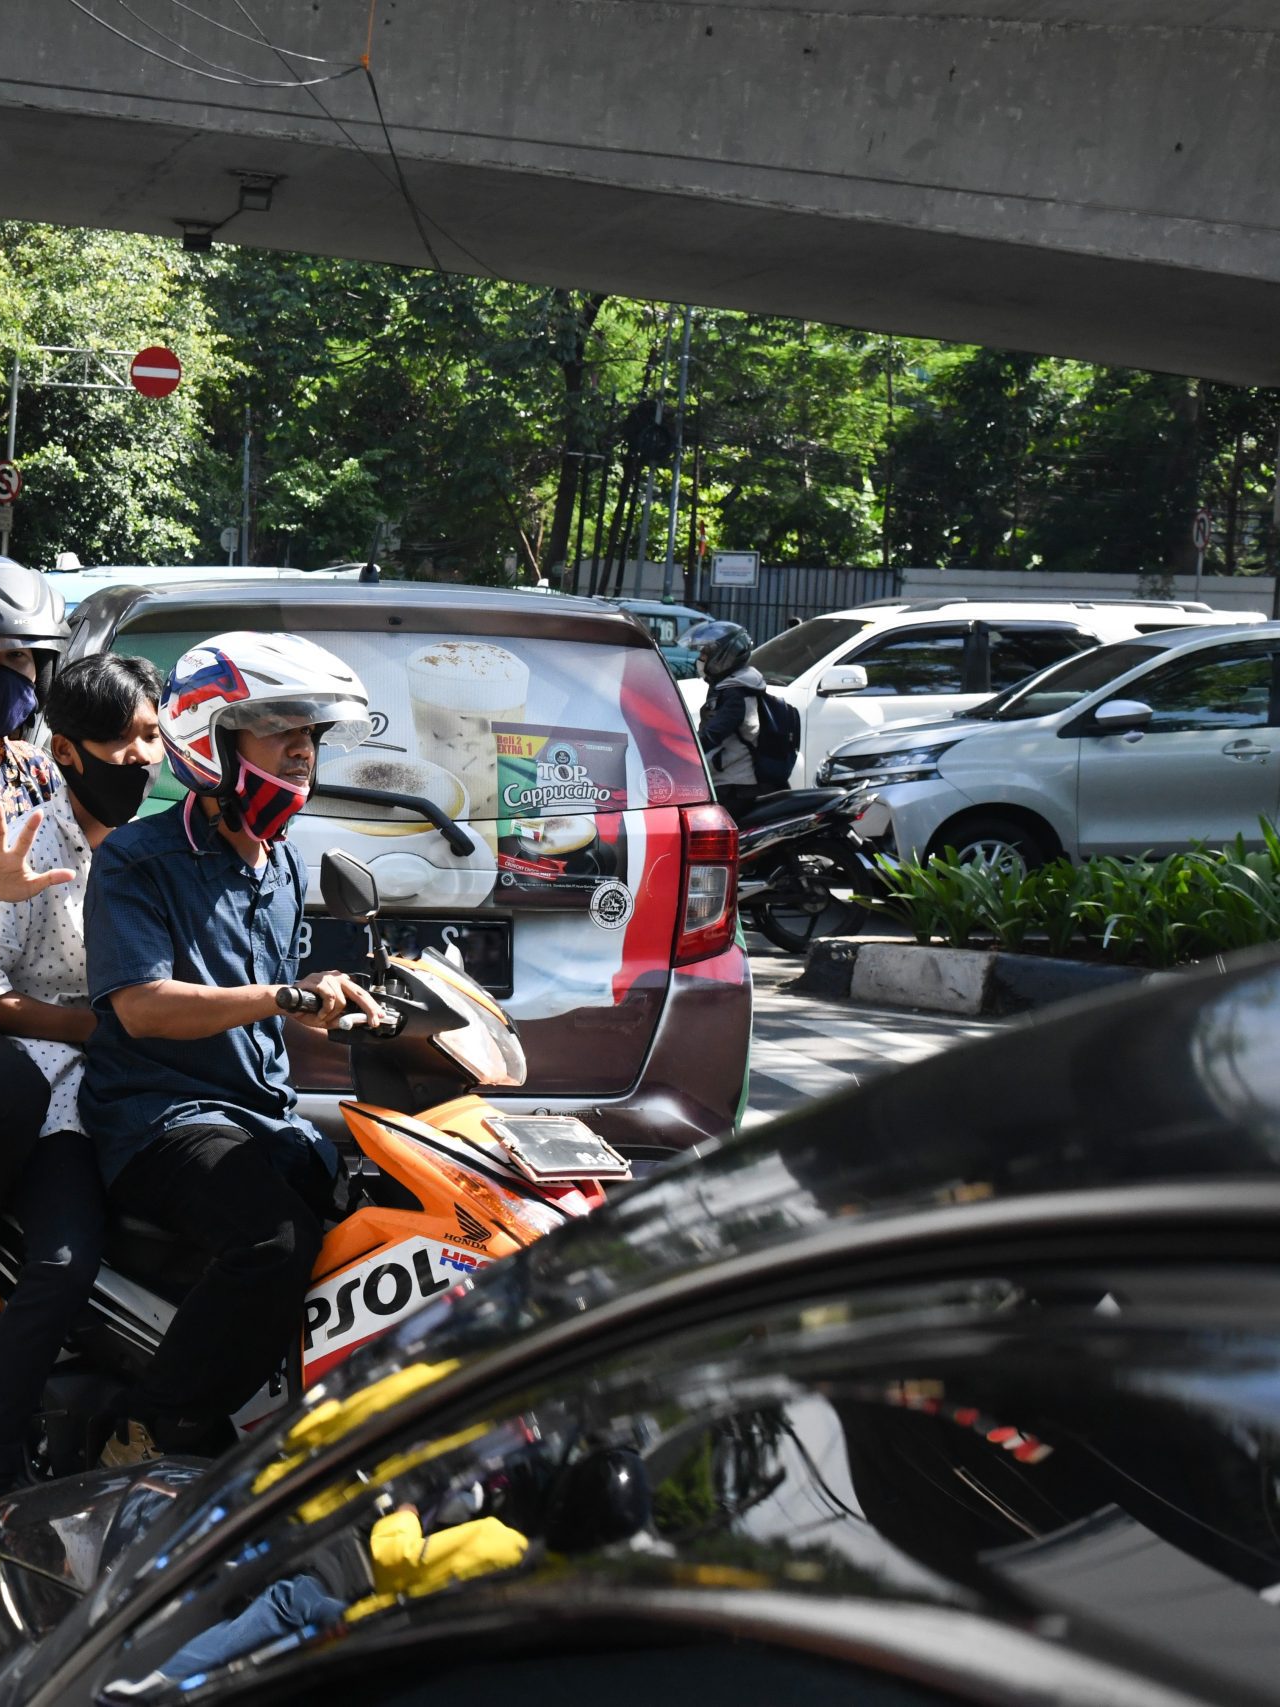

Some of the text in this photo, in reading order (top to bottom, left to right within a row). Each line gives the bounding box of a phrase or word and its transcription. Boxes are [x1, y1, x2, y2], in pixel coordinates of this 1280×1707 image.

[660, 620, 674, 641] 16
[496, 742, 533, 756] EXTRA 1
[516, 736, 522, 745] 2
[537, 762, 588, 784] TOP
[503, 782, 611, 808] Cappuccino
[443, 1232, 489, 1252] HONDA
[304, 1248, 450, 1352] PSOL
